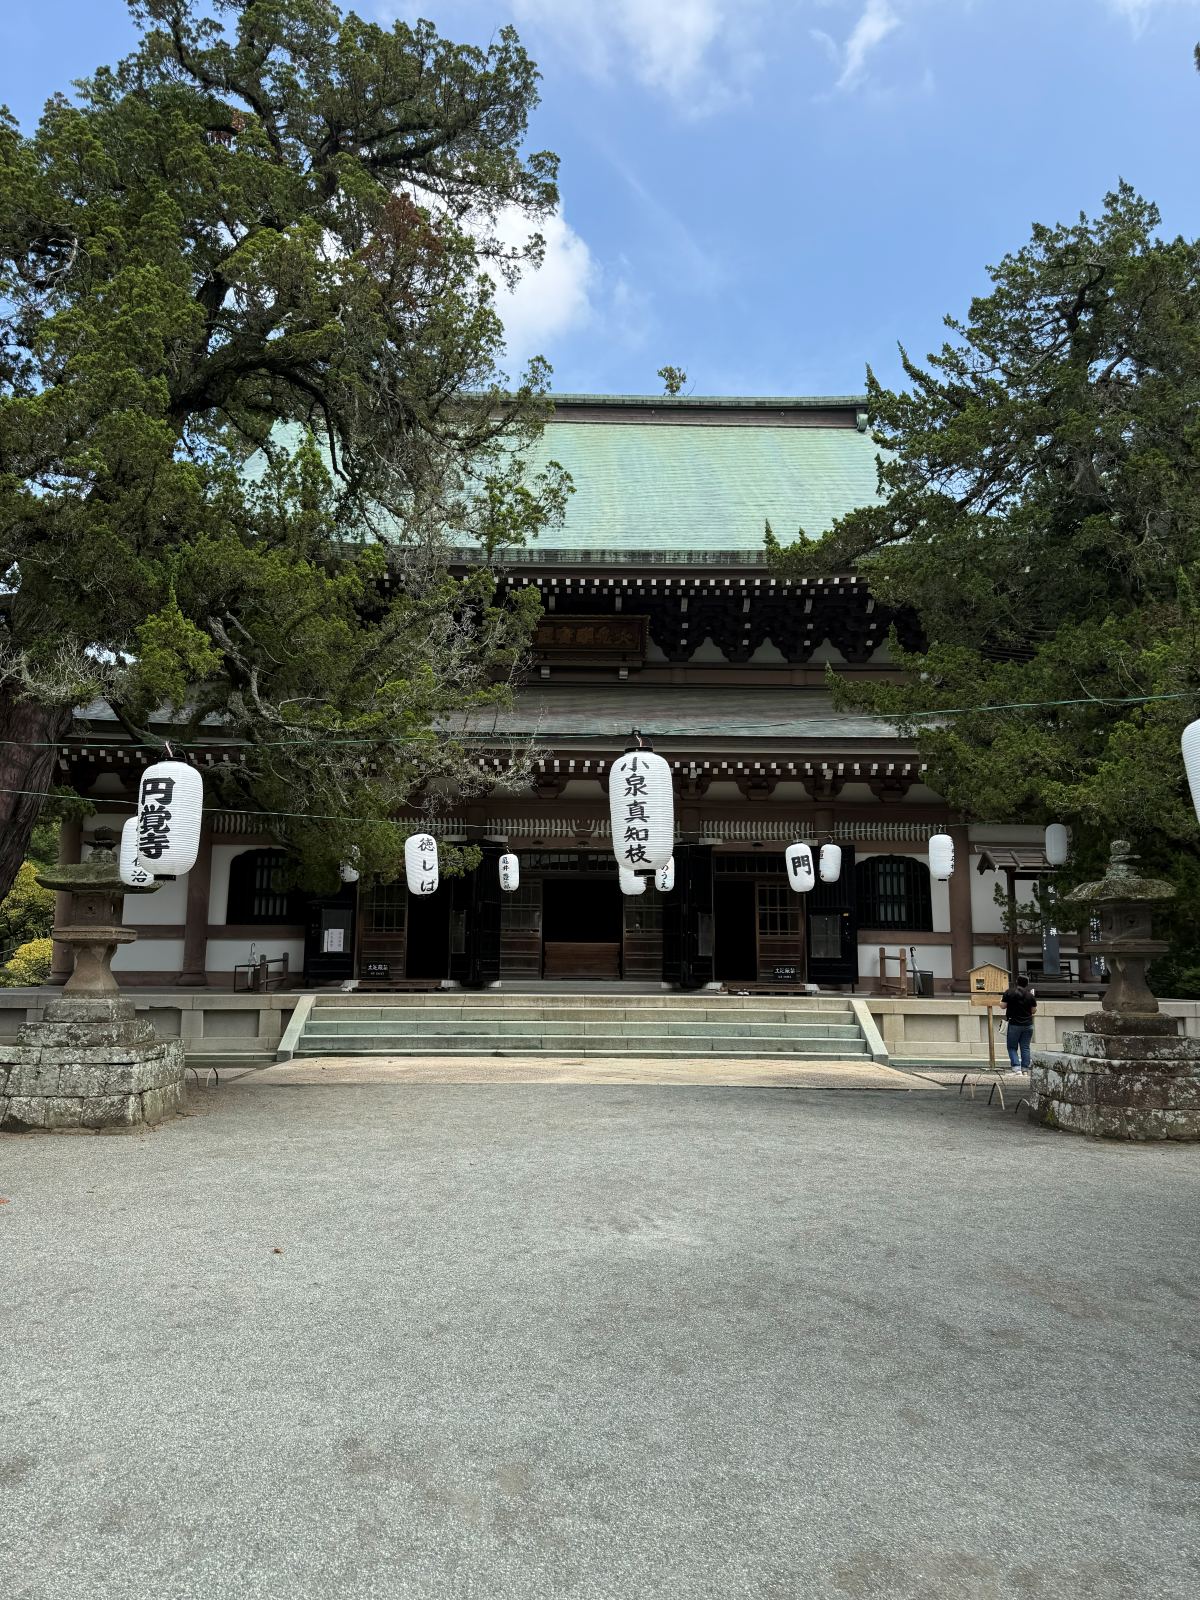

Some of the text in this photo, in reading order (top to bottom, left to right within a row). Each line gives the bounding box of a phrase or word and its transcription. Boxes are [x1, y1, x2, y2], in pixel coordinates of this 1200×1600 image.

[140, 776, 176, 860] 円覚寺
[620, 756, 652, 864] 小泉真知枝
[418, 837, 437, 892] 徳しば
[791, 854, 812, 877] 門
